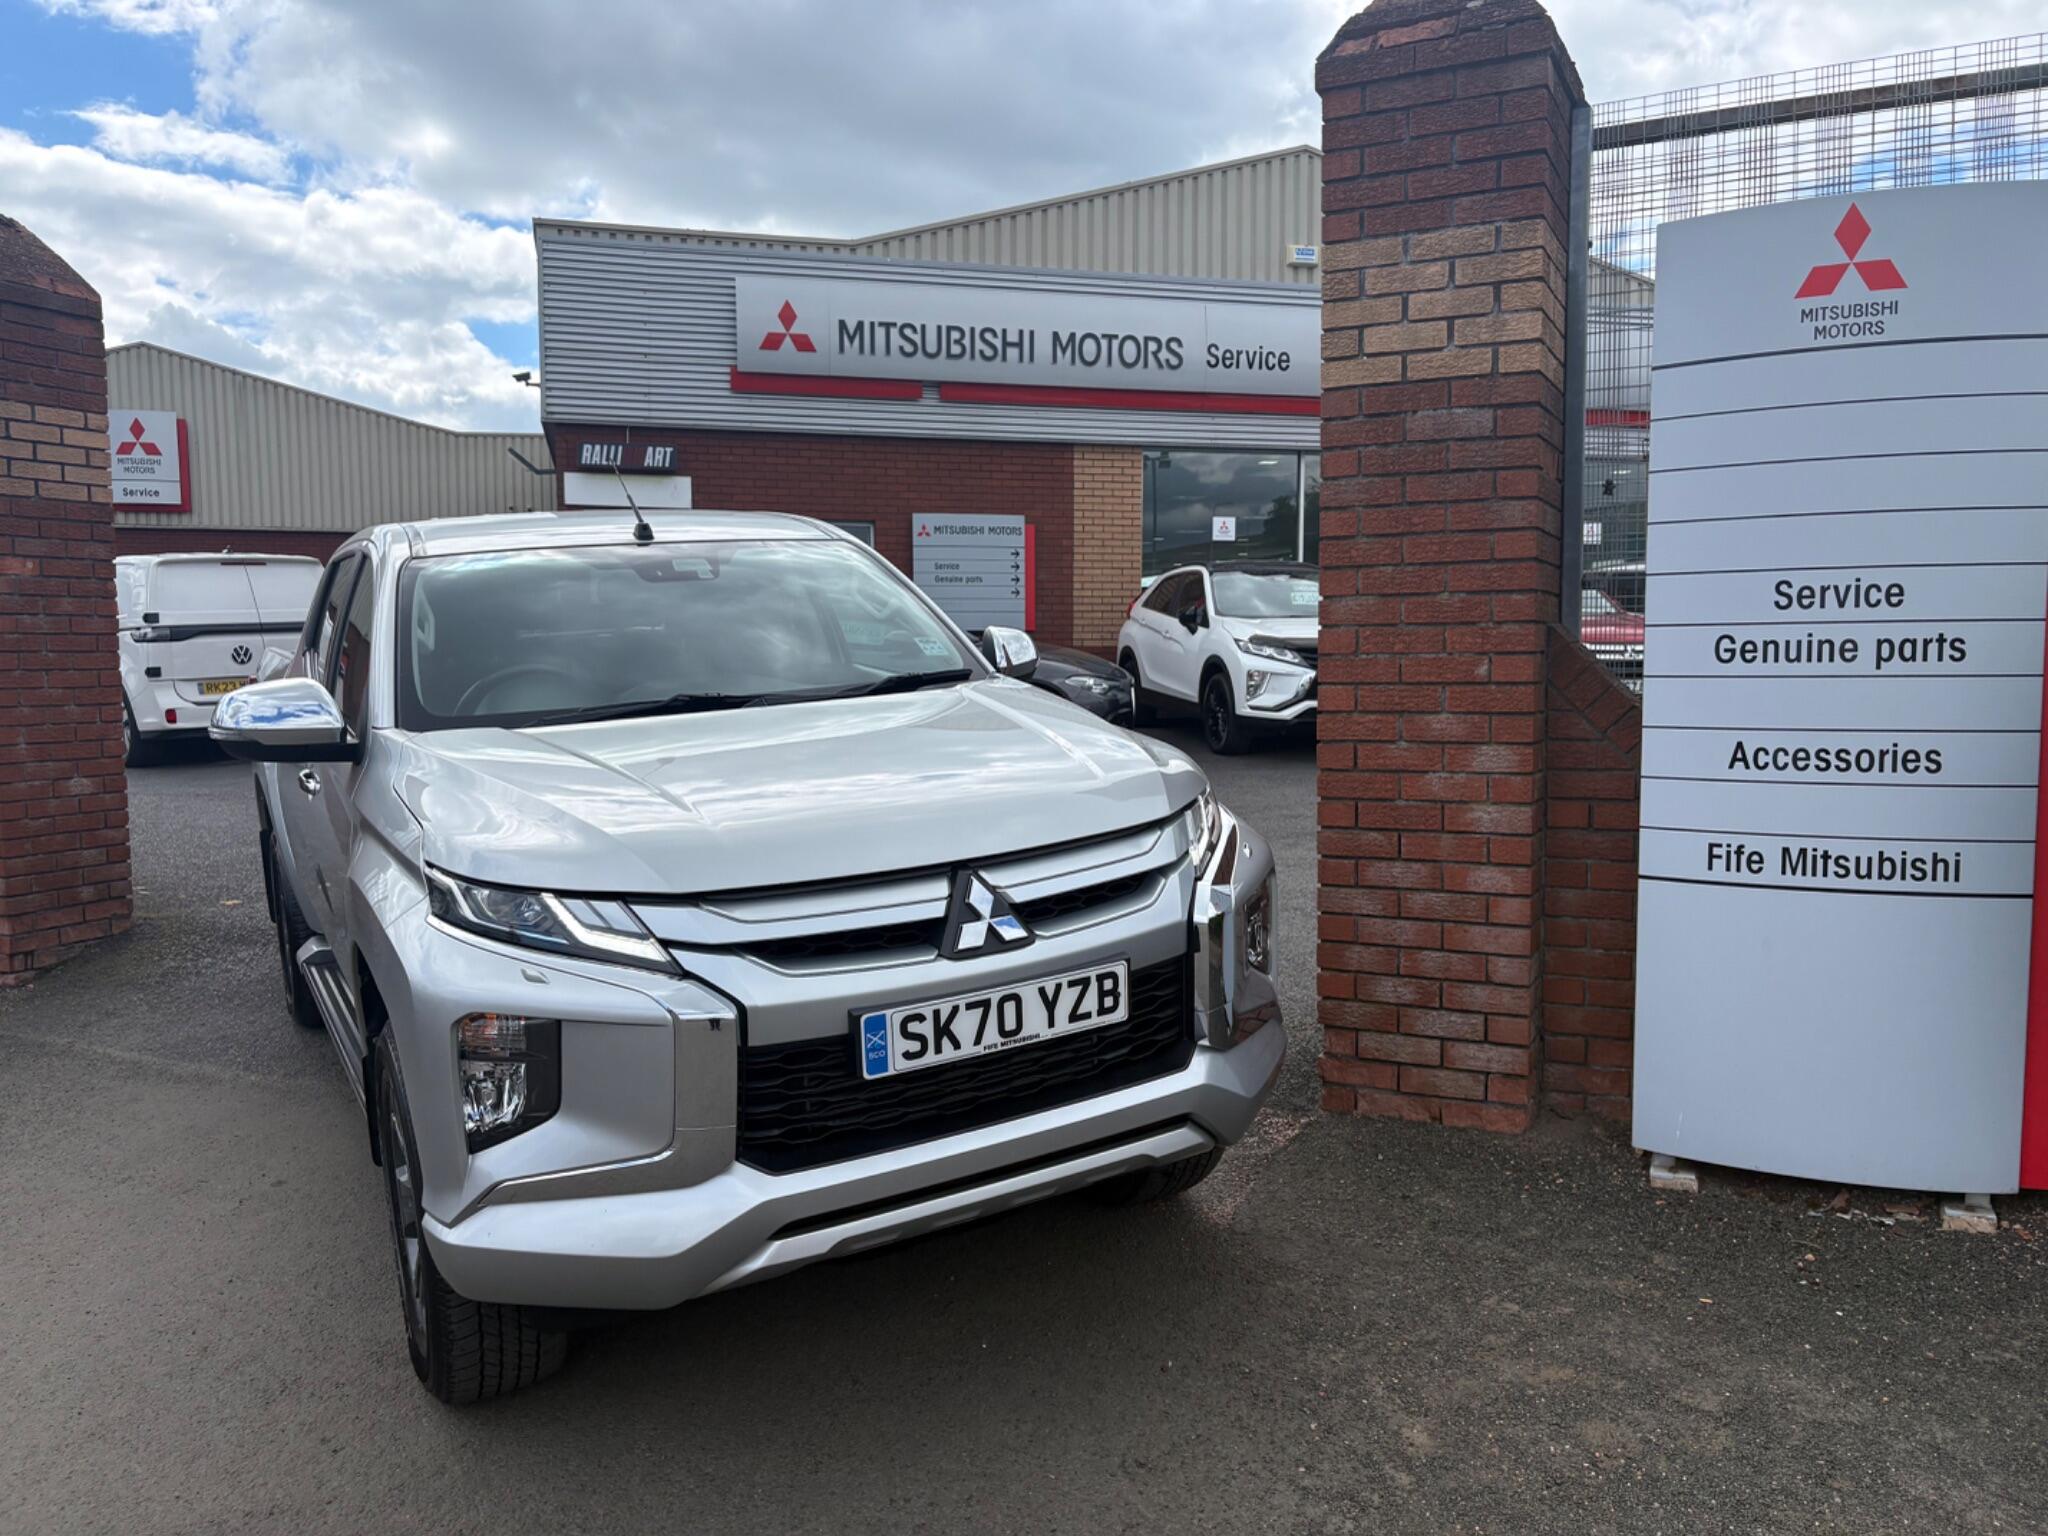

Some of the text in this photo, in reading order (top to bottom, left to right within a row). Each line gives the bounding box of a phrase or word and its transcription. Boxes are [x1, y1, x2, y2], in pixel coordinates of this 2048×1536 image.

[1800, 300, 1898, 323] MITSUBISHI
[1813, 320, 1885, 340] MOTORS
[838, 318, 1291, 372] MITSUBISHI MOTORS Service
[117, 457, 162, 466] MITSUBISHI
[643, 445, 674, 468] ART
[123, 466, 156, 474] MOTORS
[122, 487, 160, 497] Service
[933, 525, 1023, 536] MITSUBISHI MOTORS
[934, 562, 960, 571] Service
[934, 575, 983, 585] Genuine parts
[1773, 577, 1905, 610] Service
[1714, 632, 1967, 670] Genuine parts
[1728, 741, 1942, 774] Accessories
[1707, 842, 1961, 882] Fife Mitsubishi
[900, 970, 1121, 1062] SK70 YZB
